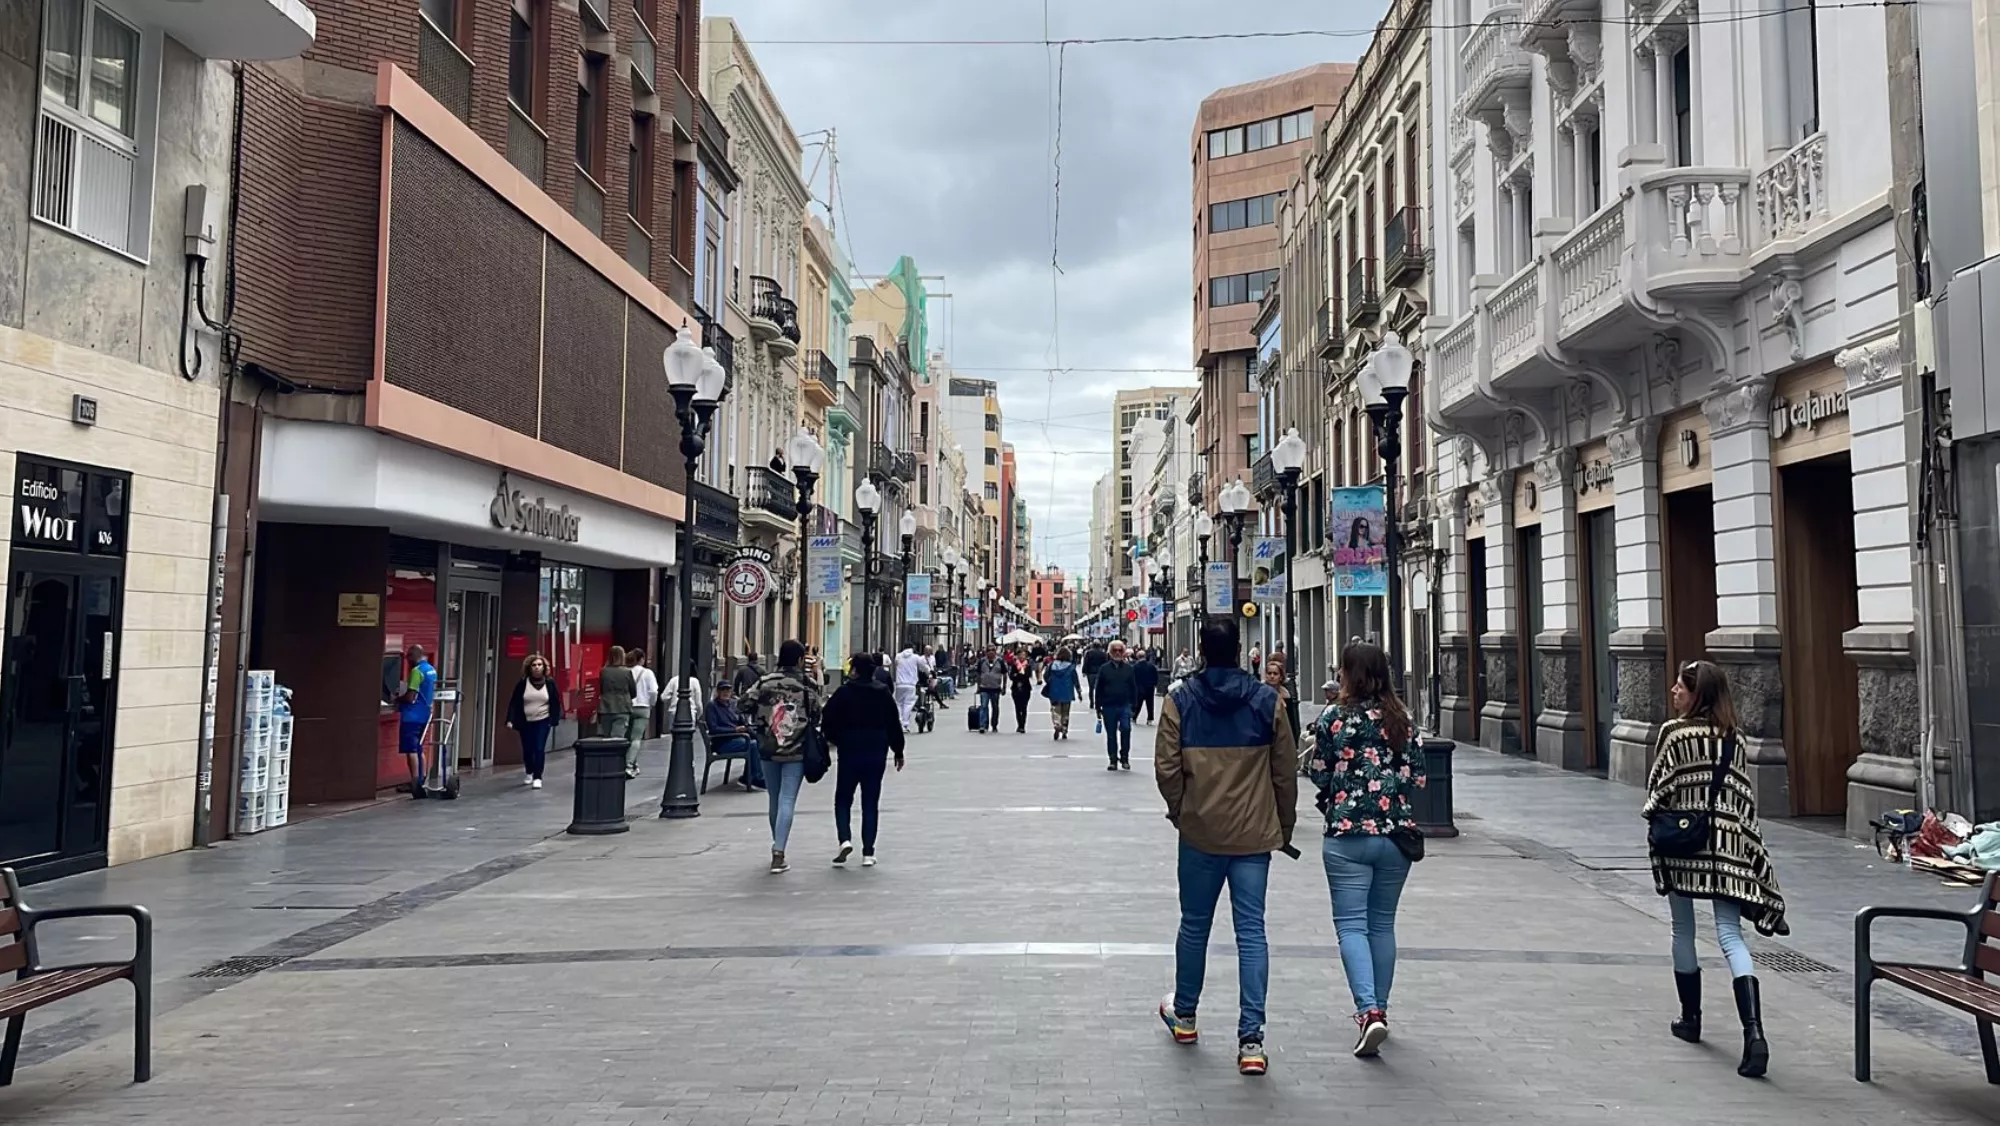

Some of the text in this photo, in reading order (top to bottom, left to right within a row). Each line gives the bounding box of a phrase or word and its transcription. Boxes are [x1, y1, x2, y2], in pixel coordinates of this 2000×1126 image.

[1790, 390, 1847, 432] cajama
[22, 478, 59, 501] Edificio
[21, 505, 77, 541] WIOT
[512, 490, 581, 543] Santander
[98, 530, 113, 545] 106
[734, 547, 771, 562] ASINO
